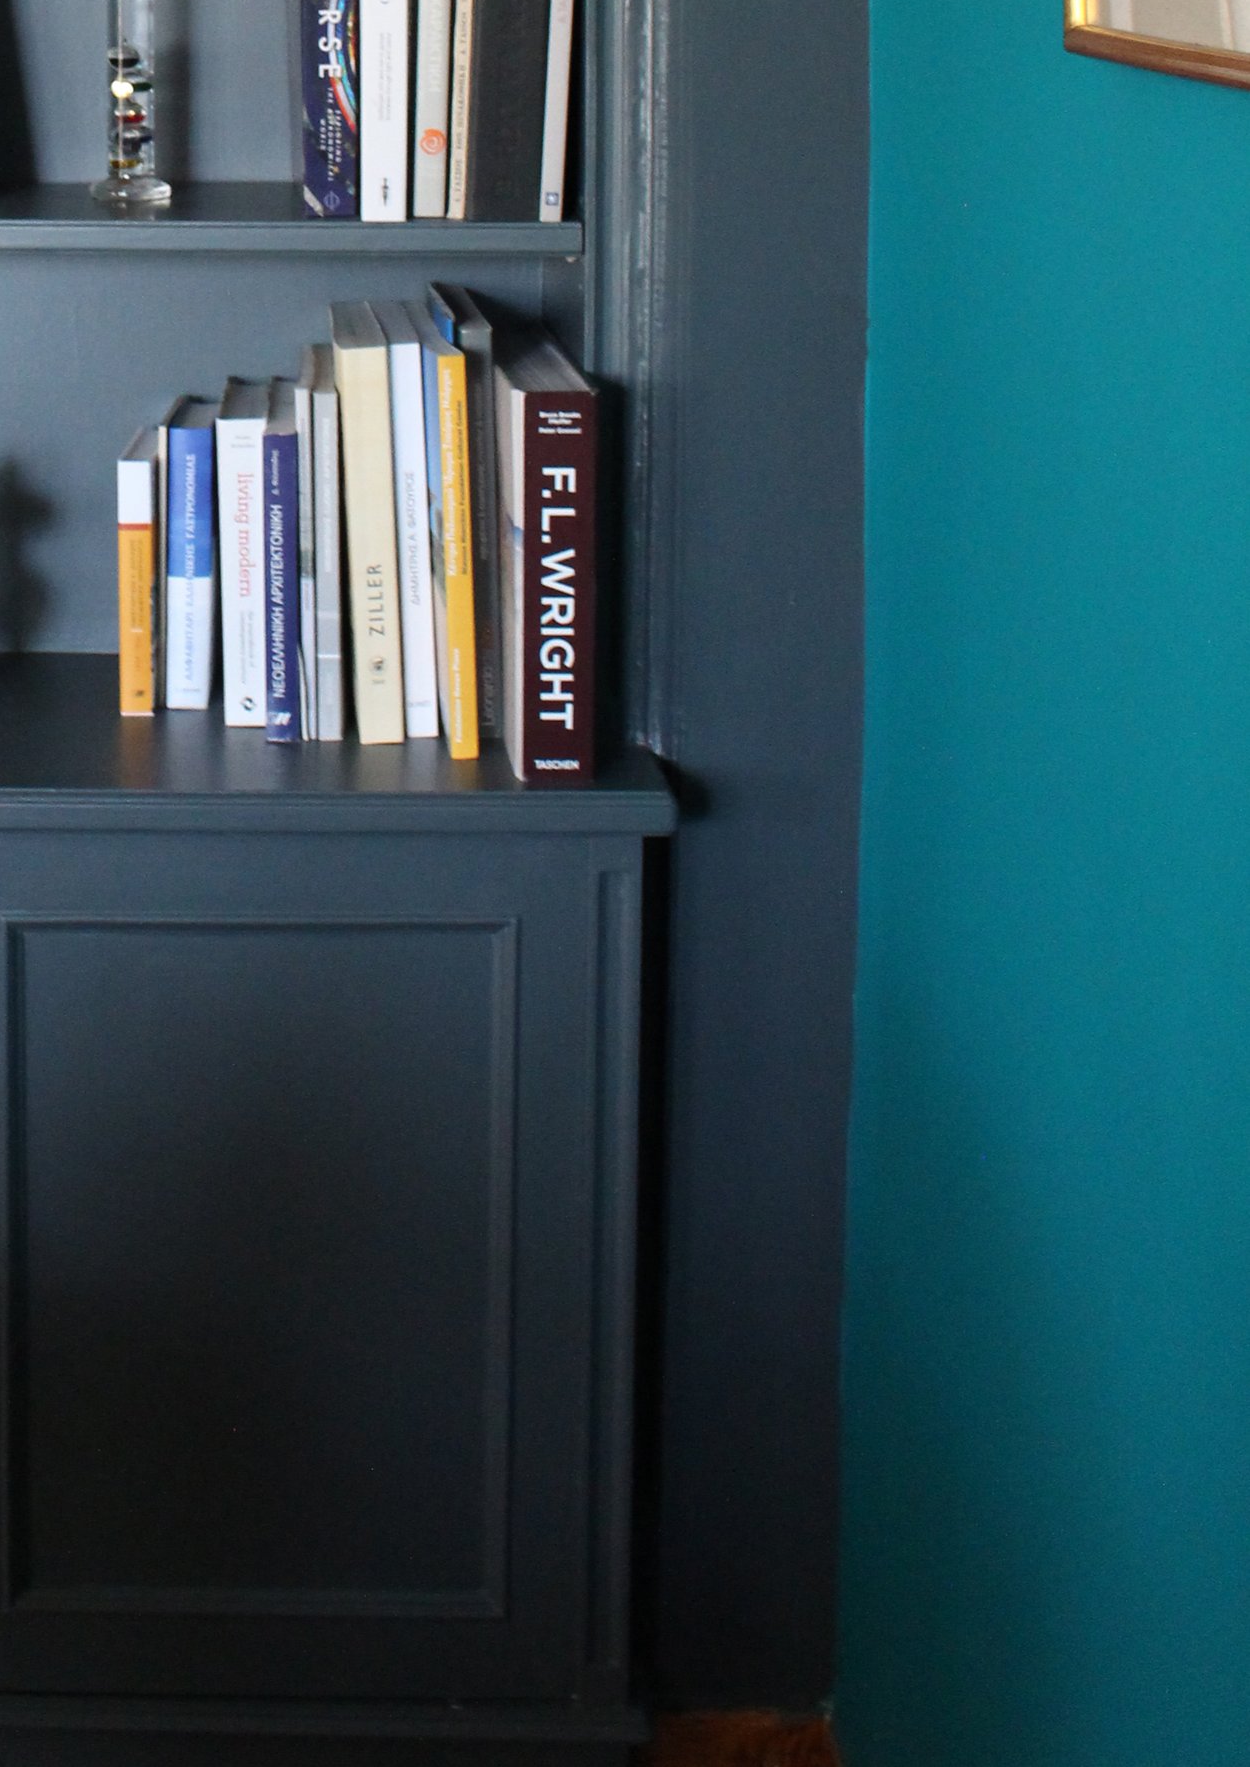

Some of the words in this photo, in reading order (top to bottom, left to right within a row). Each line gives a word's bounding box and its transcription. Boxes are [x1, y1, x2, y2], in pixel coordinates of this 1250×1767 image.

[326, 88, 335, 105] THE
[319, 119, 327, 152] WORLD
[326, 108, 335, 183] ASTRONOMICAL
[334, 110, 342, 164] EXPLORING
[184, 453, 196, 539] ΓΑΣΤΡΟΝΟΜΙΑΣ
[233, 472, 254, 524] living
[405, 472, 417, 529] ΦΑΤΟΥΡΟΣ
[238, 529, 256, 598] modern
[270, 504, 285, 605] ΑΡΧΙΤΕΚΤΟΝΙΚΗ
[408, 545, 421, 606] ΔΗΜΗΤΡΗΣ
[446, 541, 458, 576] Κέντρο
[367, 564, 386, 637] ZILLER
[271, 607, 287, 698] ΝΕΟΕΛΛΗΝΙΚΗ
[452, 648, 461, 672] Piano
[539, 549, 575, 730] WRIGHT
[453, 672, 462, 698] Renzo
